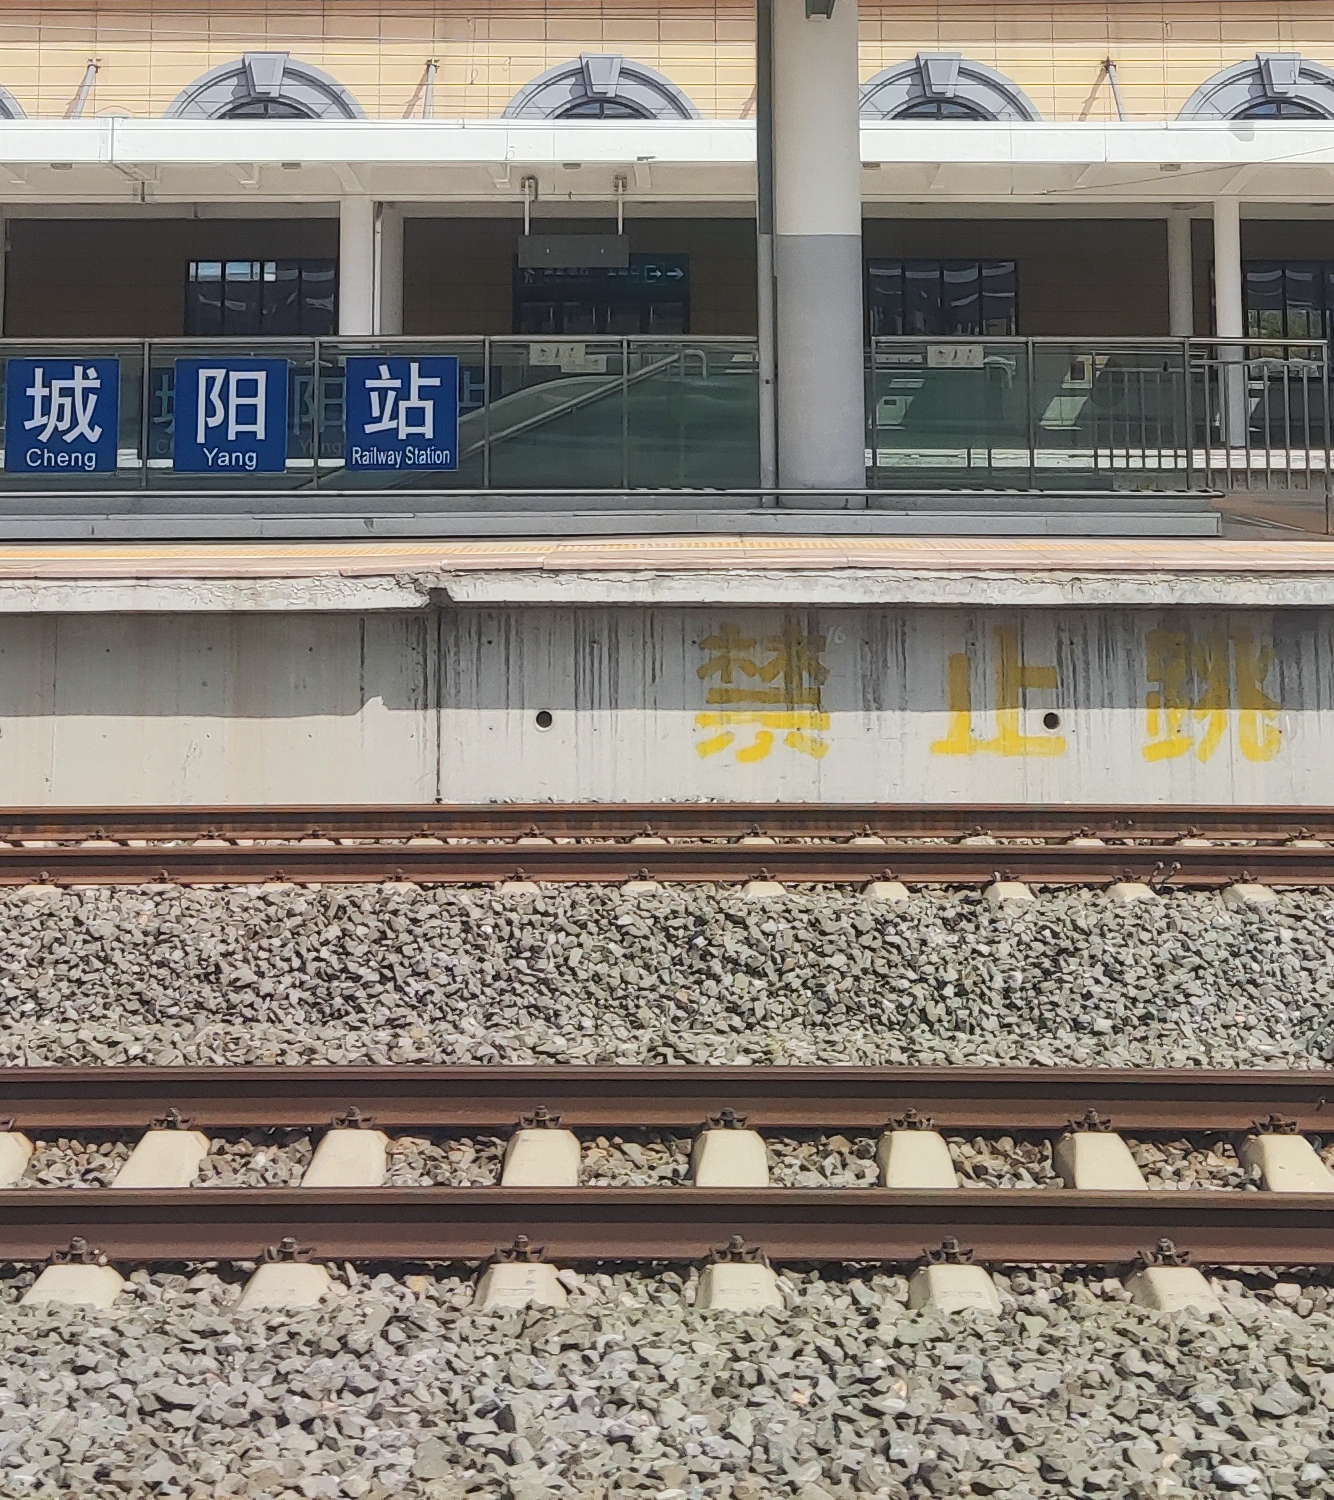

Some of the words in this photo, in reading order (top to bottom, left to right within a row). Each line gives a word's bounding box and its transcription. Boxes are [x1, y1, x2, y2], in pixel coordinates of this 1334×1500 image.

[23, 365, 103, 443] 城
[196, 368, 267, 444] 阳
[363, 362, 442, 440] 站
[26, 448, 97, 471] Cheng
[203, 447, 257, 470] Yang
[351, 446, 403, 469] Railway
[405, 445, 451, 465] Station
